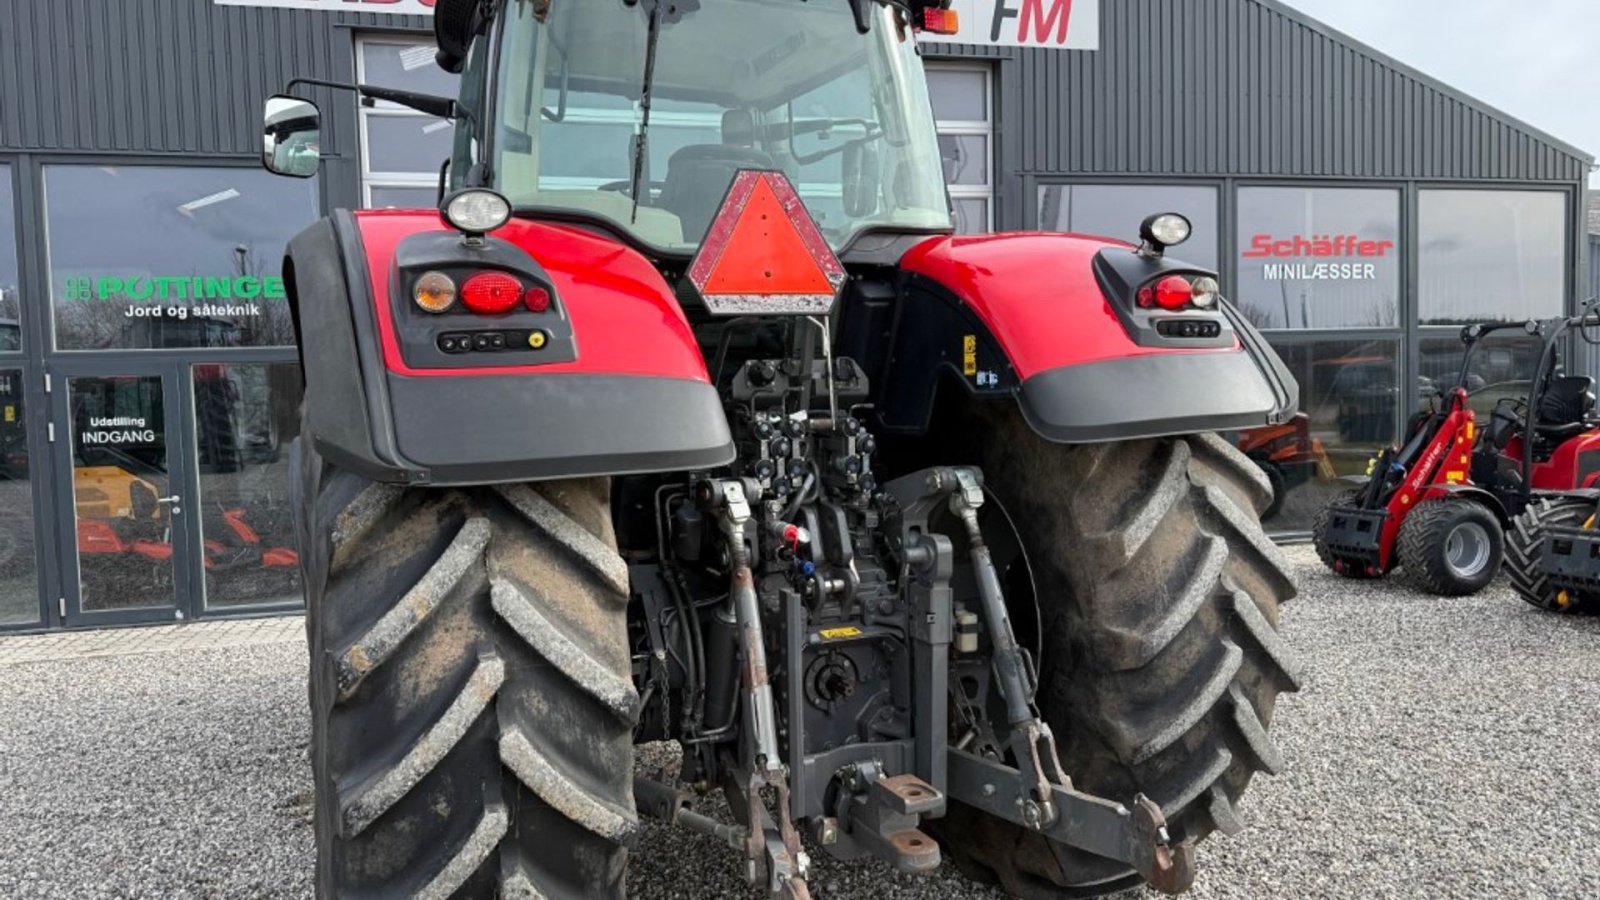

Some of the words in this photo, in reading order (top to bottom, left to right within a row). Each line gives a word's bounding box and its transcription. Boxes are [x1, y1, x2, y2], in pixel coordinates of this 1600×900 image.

[1242, 234, 1393, 257] Schäffer
[1264, 263, 1376, 280] MINILÆSSER
[125, 304, 162, 317] Jord
[167, 307, 187, 319] og
[192, 303, 259, 316] såteknik
[90, 417, 145, 427] Udstilling
[82, 430, 155, 443] INDGANG
